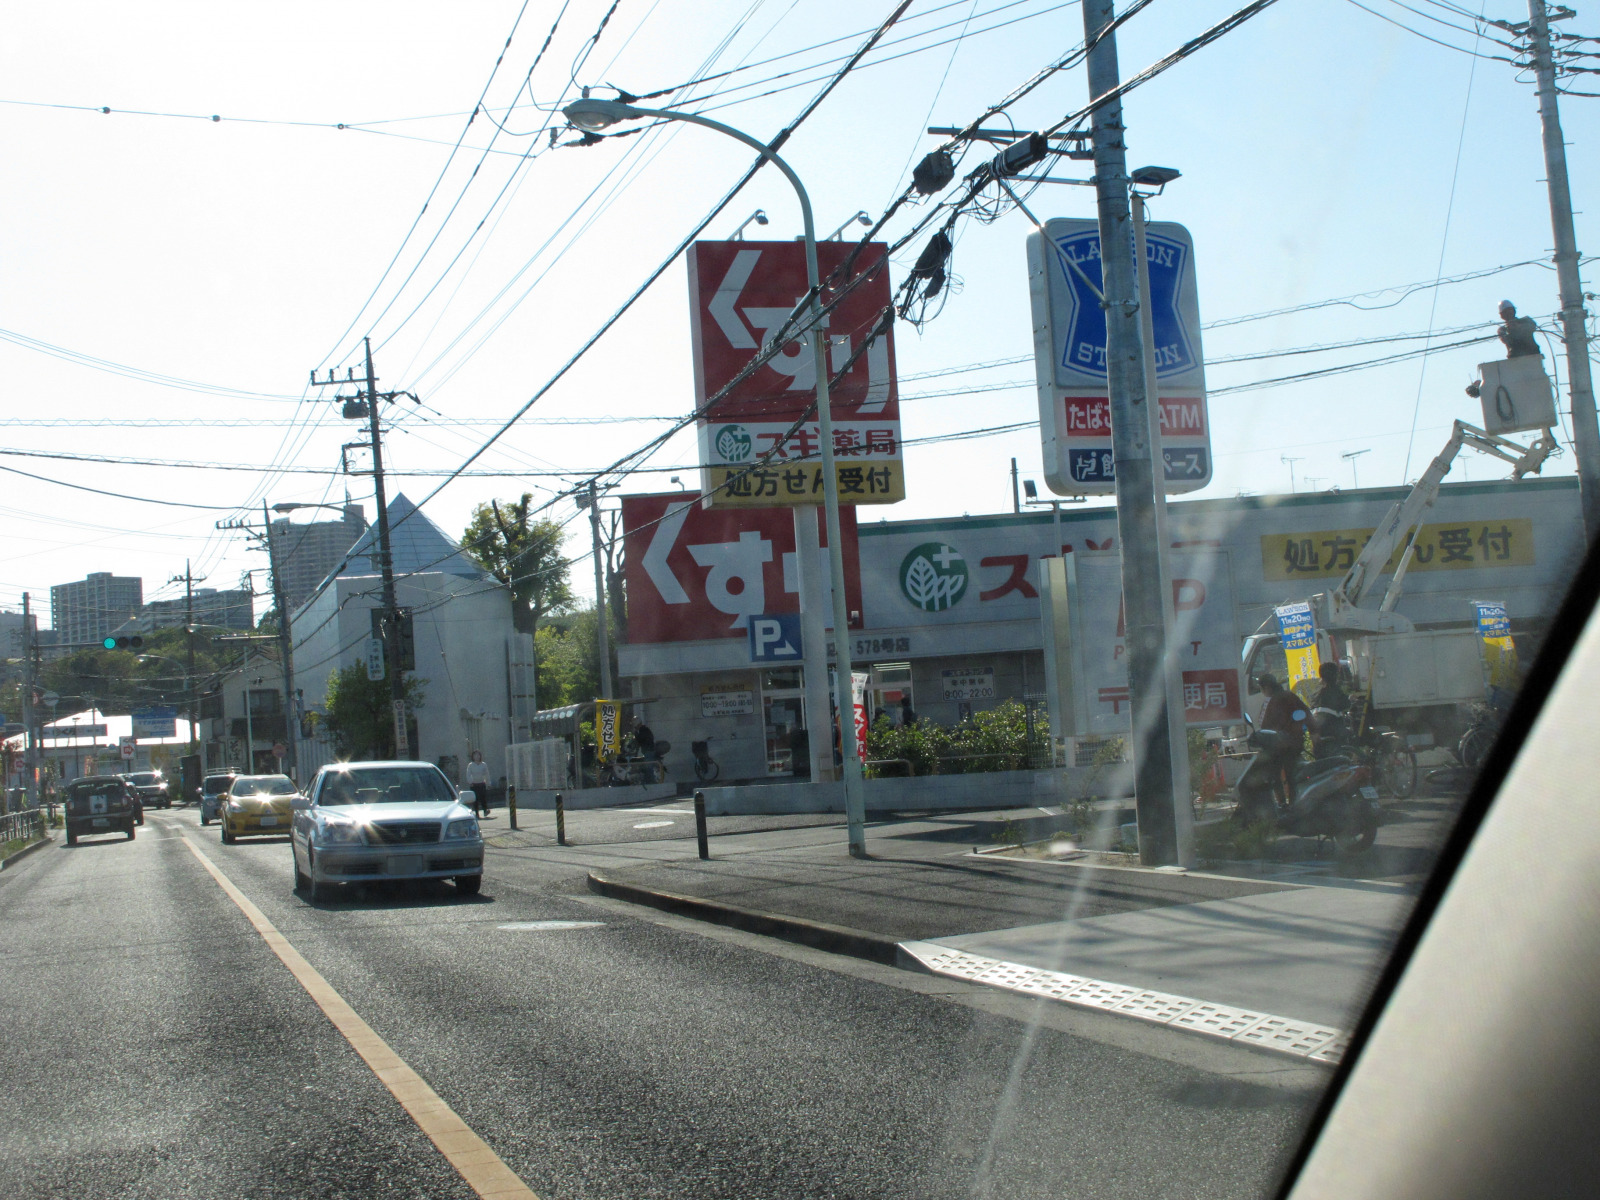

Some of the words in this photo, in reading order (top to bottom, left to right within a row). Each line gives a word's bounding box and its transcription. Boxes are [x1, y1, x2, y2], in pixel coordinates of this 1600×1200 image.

[1067, 240, 1175, 268] LAON
[707, 249, 891, 414] くすり
[1077, 341, 1181, 368] STON
[1159, 403, 1201, 429] ATM
[755, 428, 896, 458] スギ薬局
[1101, 453, 1202, 477] 飲ペース
[1284, 525, 1513, 574] 処方ん受付
[755, 619, 782, 657] P
[1112, 640, 1202, 661] PT
[1183, 681, 1228, 710] 便局
[601, 704, 616, 758] 処方せん
